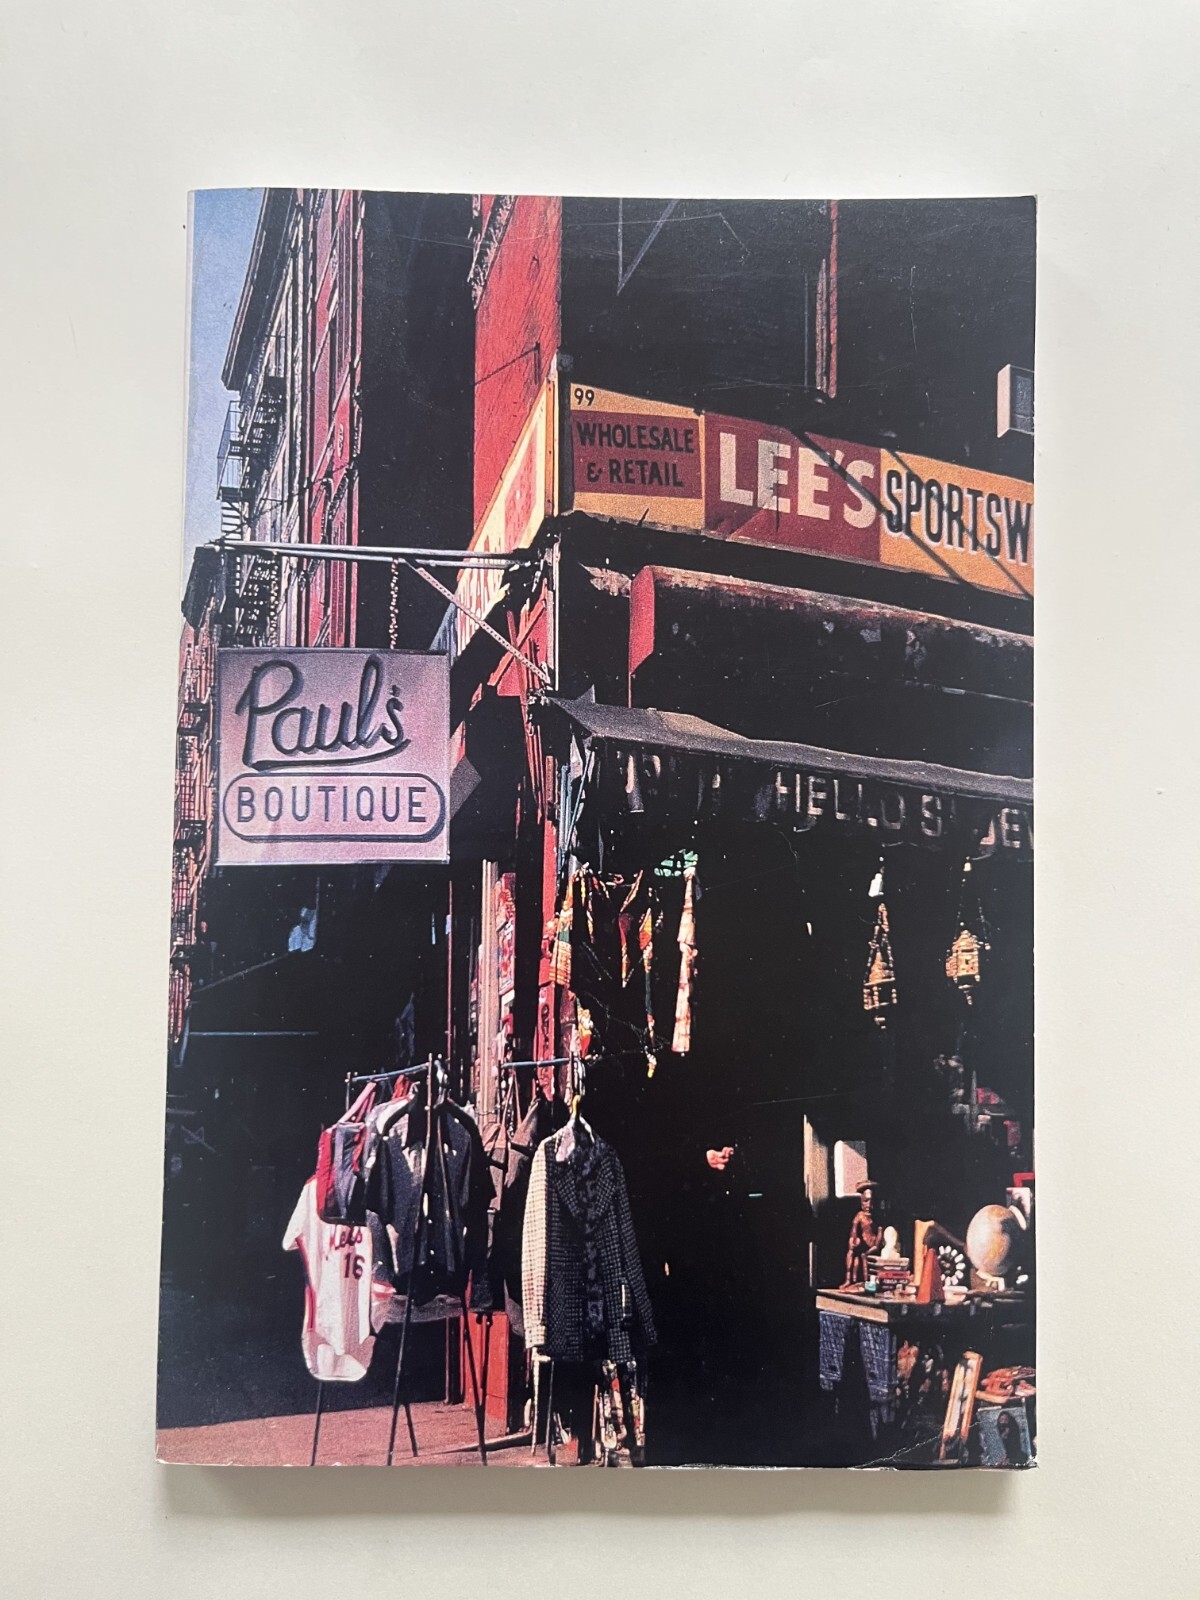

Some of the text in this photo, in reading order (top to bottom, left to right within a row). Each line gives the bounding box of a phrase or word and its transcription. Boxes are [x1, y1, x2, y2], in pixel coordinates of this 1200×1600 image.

[574, 387, 595, 406] 99
[576, 421, 695, 454] WHOLESALE
[587, 458, 685, 487] & RETAIL
[719, 432, 1033, 565] LEE'S SPORTSW
[235, 654, 411, 771] Paul's
[237, 785, 427, 823] BOUTIQUE
[344, 1252, 365, 1280] 16
